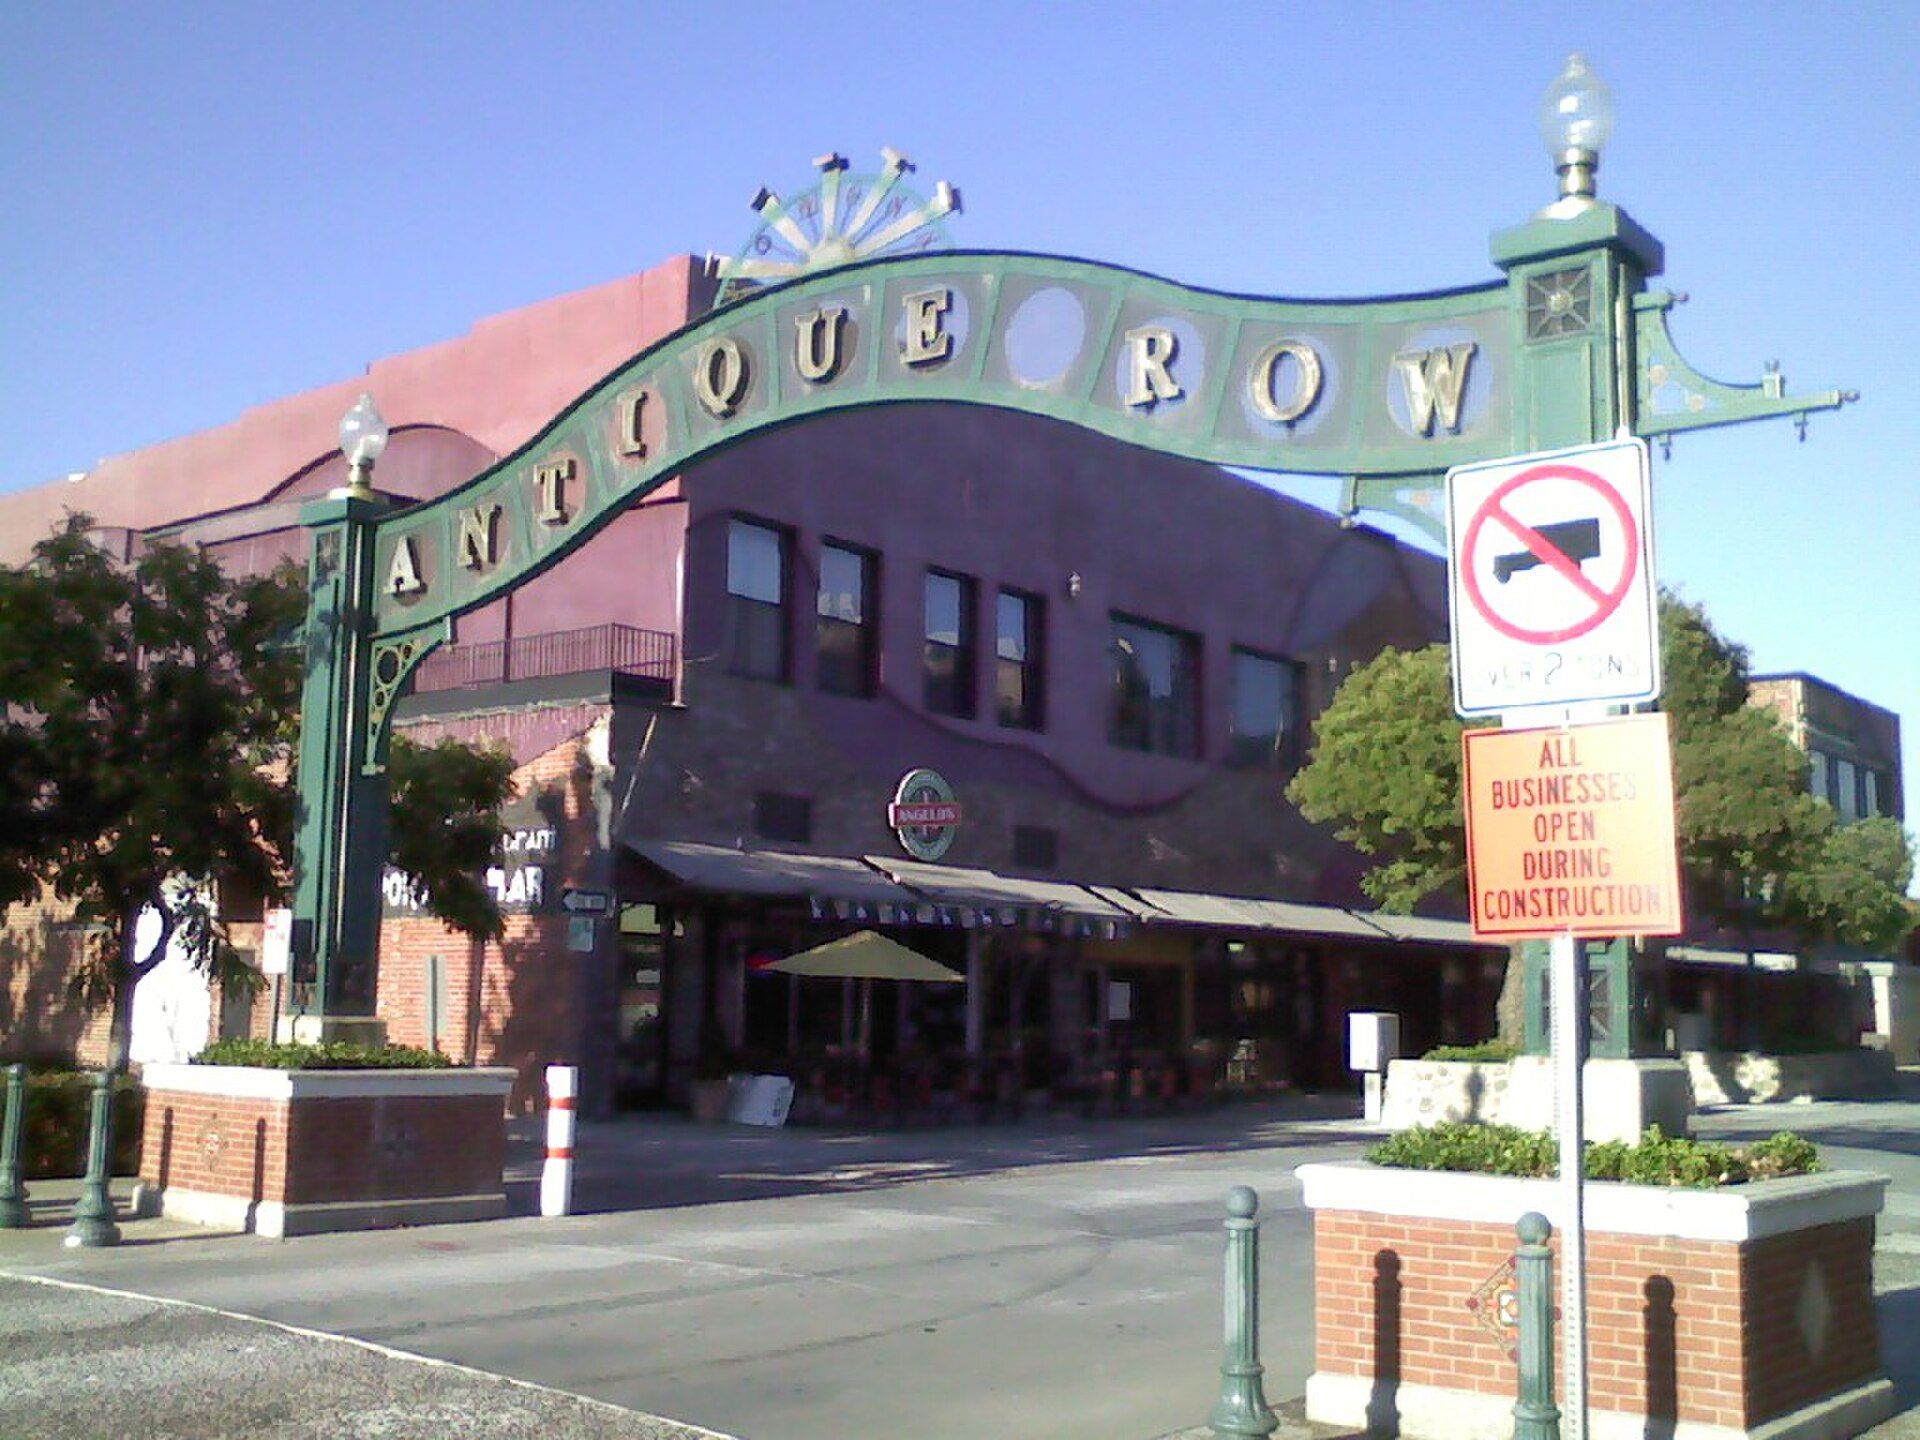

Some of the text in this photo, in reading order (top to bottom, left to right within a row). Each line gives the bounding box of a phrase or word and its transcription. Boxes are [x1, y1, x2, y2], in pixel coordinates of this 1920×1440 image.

[383, 289, 1479, 598] ANTIQUE ROW
[1539, 736, 1583, 769] ALL
[1491, 772, 1637, 810] BUSINESSES
[1534, 811, 1596, 842] OPEN
[1523, 847, 1613, 881] DURING
[1484, 884, 1662, 920] CONSTRUCTION
